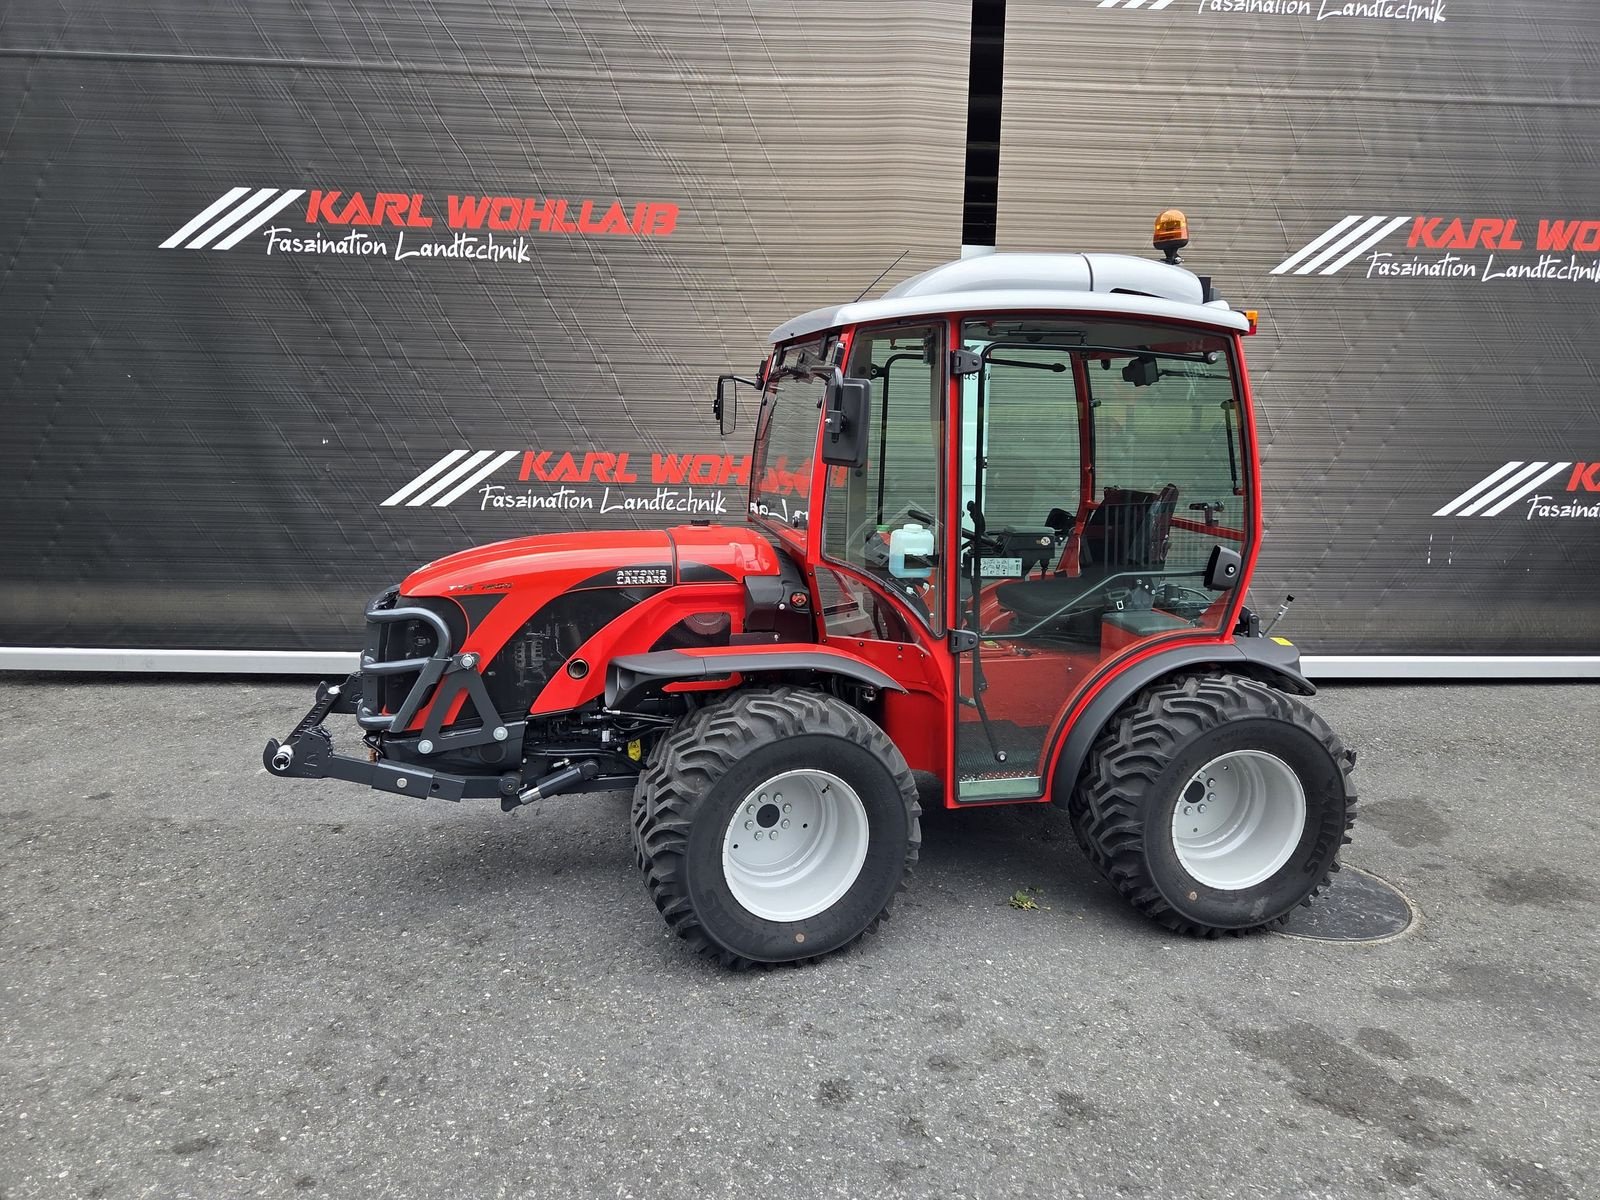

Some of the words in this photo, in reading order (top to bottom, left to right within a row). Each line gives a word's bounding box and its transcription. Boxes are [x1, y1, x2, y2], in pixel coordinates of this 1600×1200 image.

[1316, 0, 1447, 24] Landtechnik
[305, 189, 433, 228] KARL
[447, 194, 680, 237] WOHLLAIB
[263, 225, 388, 257] Faszination
[394, 230, 531, 264] Landtechnik
[1407, 216, 1522, 250] KARL
[1536, 219, 1600, 252] WO
[1364, 250, 1476, 279] Faszination
[518, 450, 638, 484] KARL
[478, 485, 594, 512] Faszination
[599, 486, 727, 515] Landtechnik
[1526, 494, 1600, 520] Faszina
[616, 569, 667, 577] ANTONIO
[616, 576, 667, 585] CARRARO
